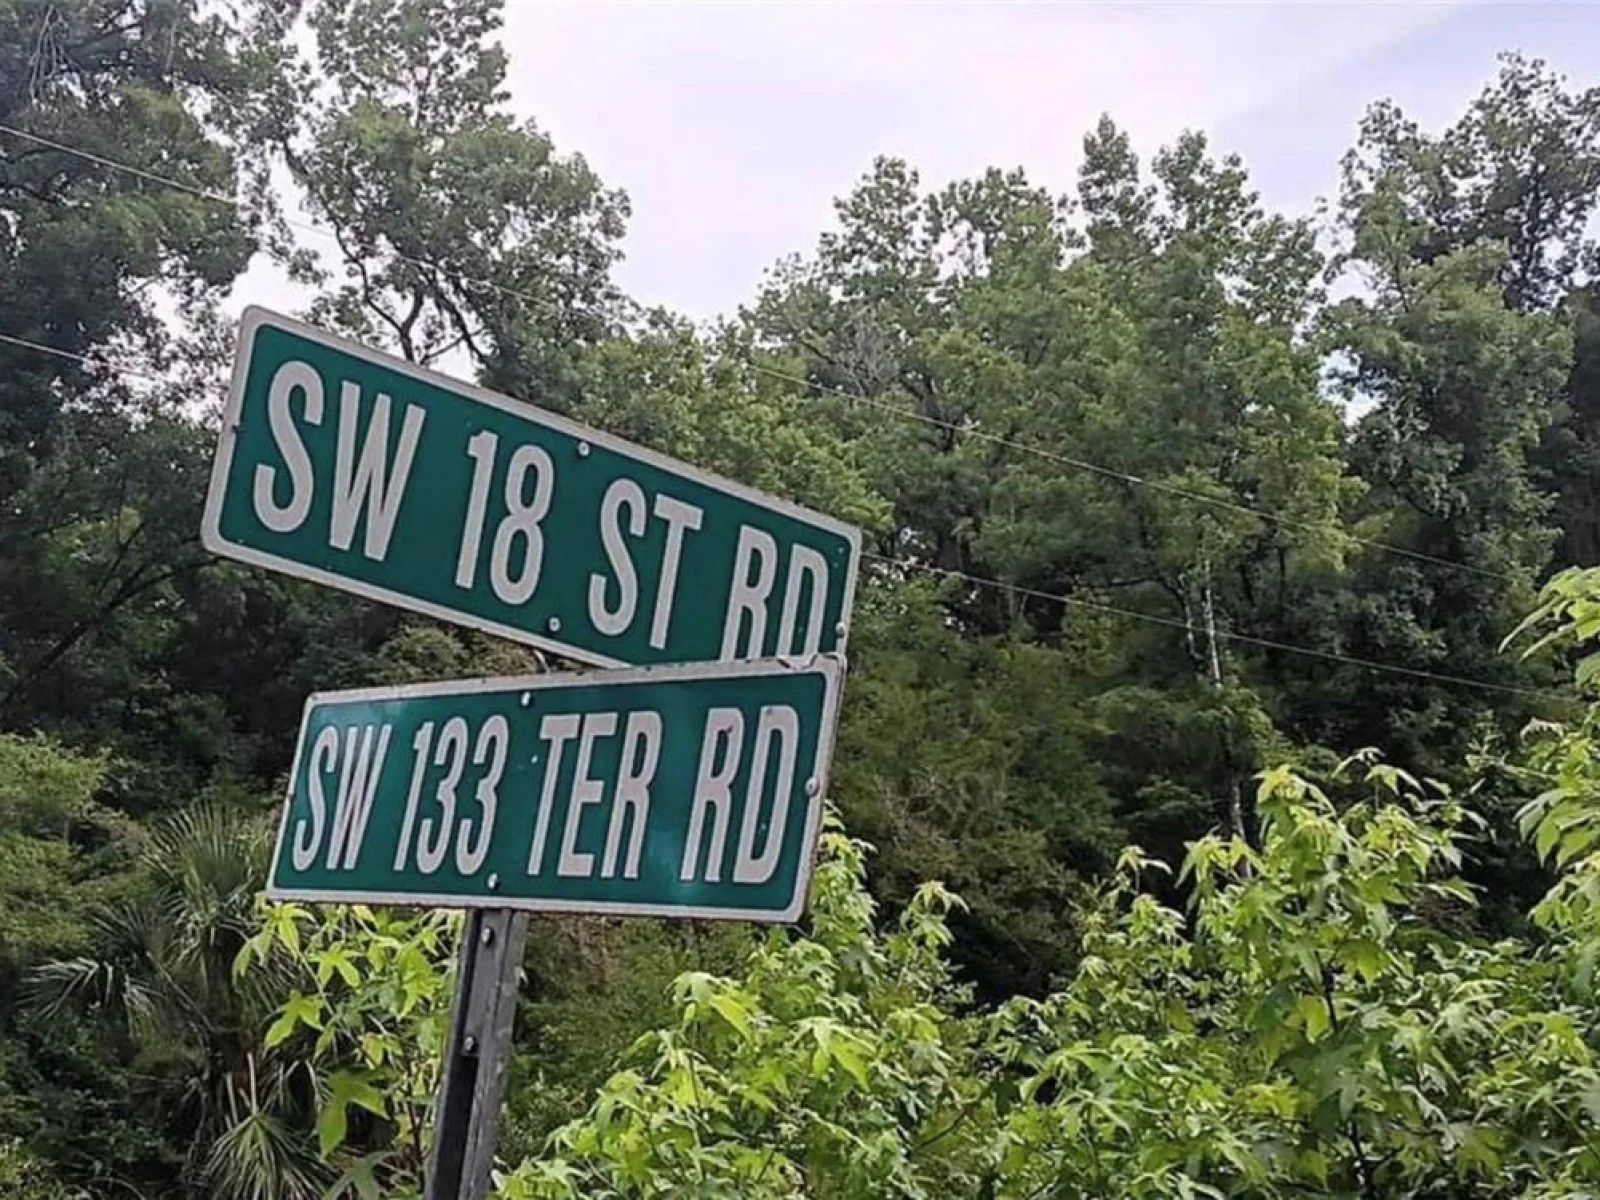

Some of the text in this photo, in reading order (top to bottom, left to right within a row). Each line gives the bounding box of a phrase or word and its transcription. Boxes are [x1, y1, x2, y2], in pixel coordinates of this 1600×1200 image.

[253, 360, 829, 662] SW 18 ST RD
[292, 705, 799, 883] SW 133 TER RD
